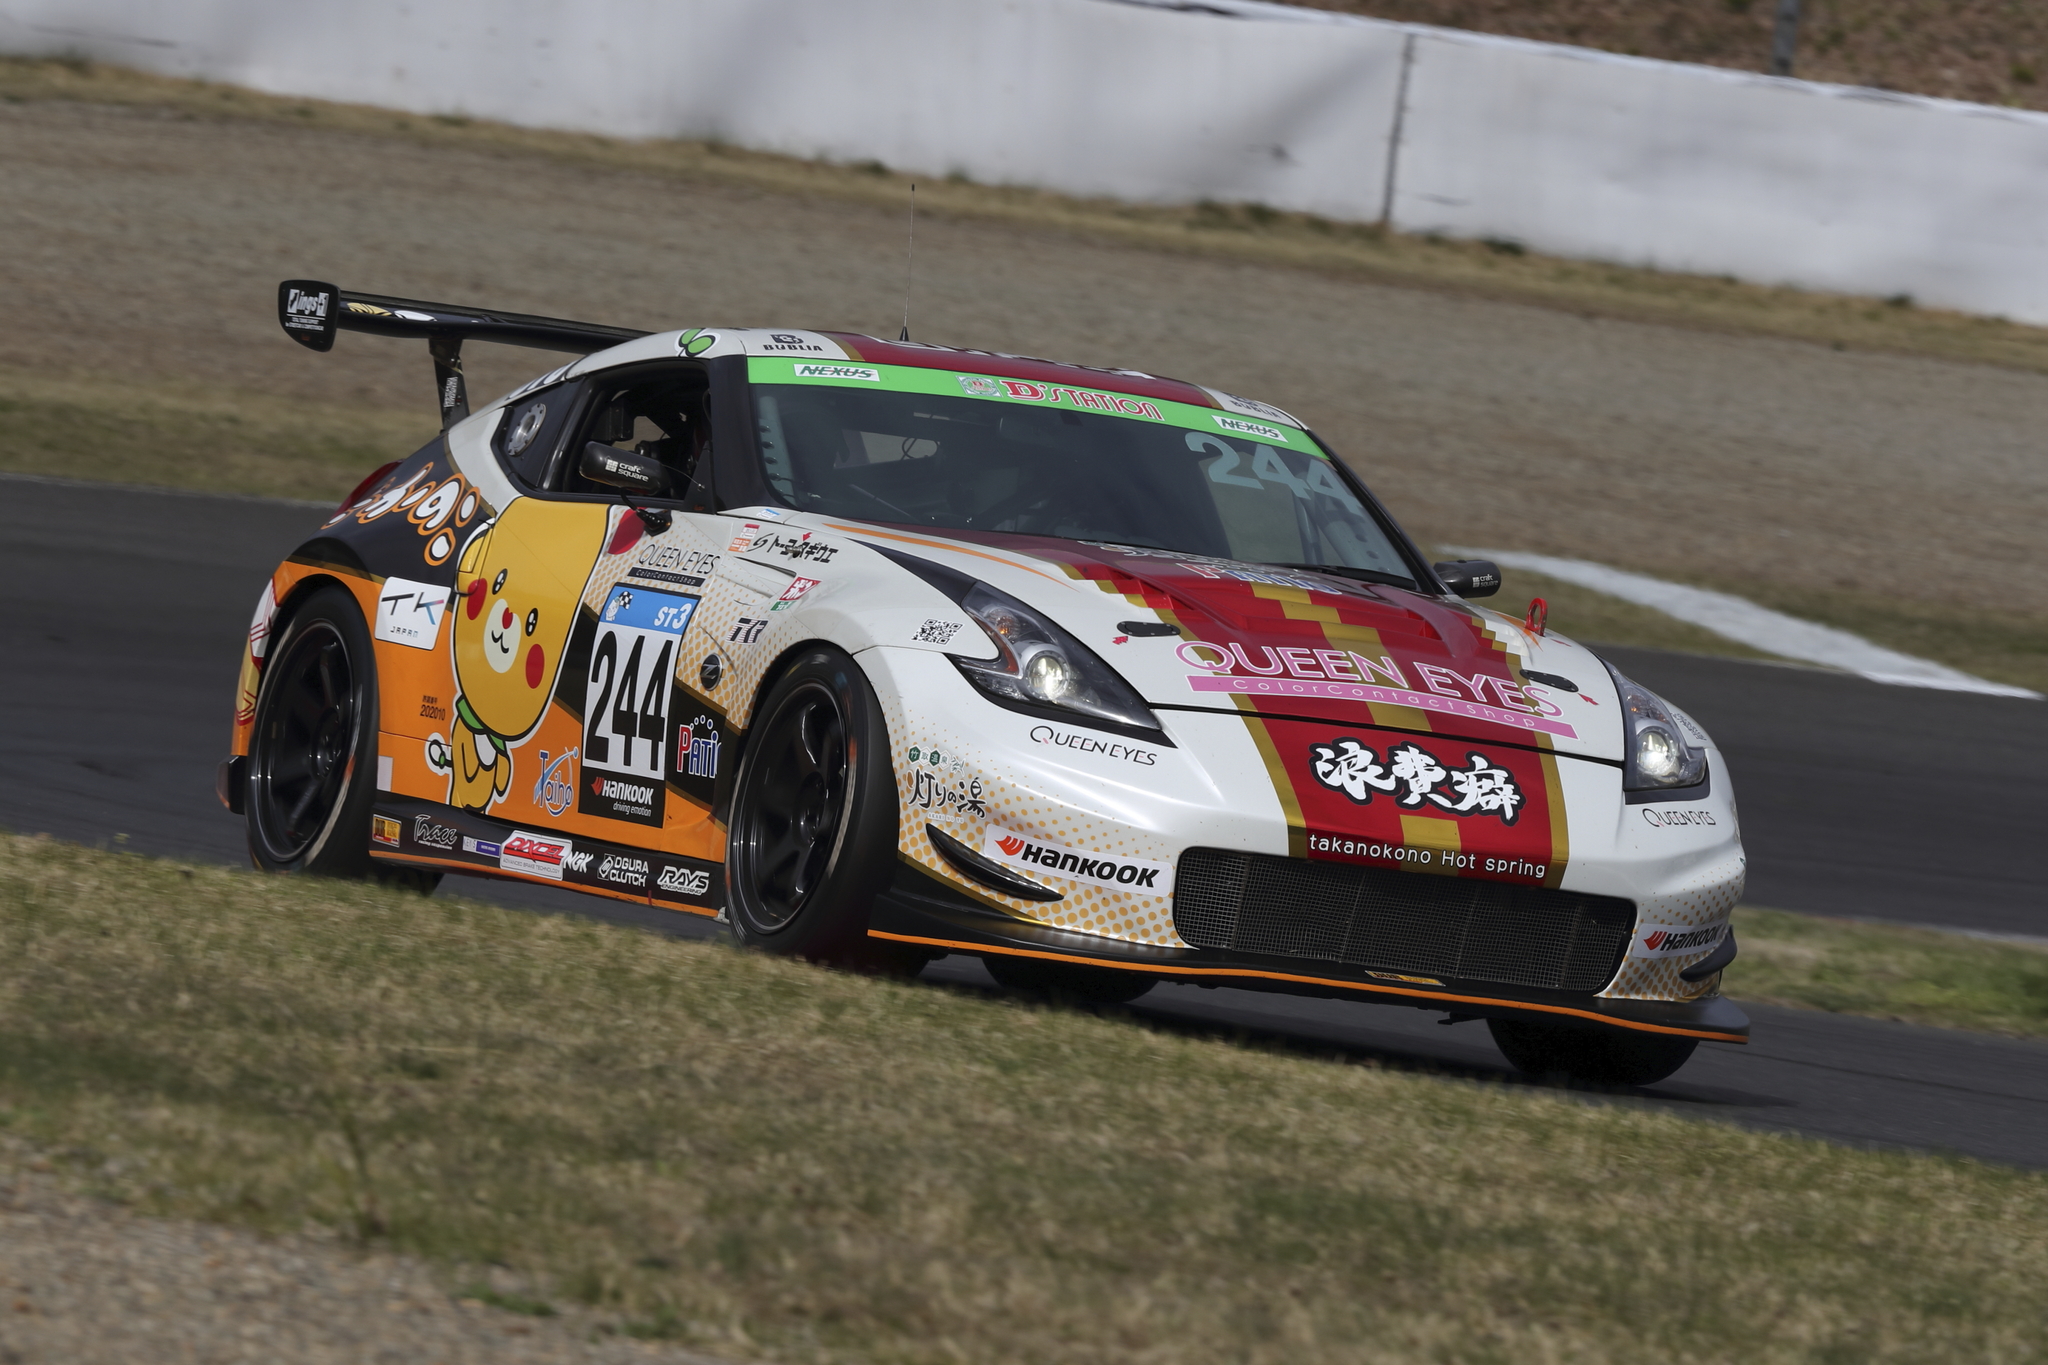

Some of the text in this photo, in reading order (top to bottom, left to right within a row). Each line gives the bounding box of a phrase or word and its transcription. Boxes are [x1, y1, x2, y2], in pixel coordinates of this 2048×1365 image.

[799, 365, 876, 379] NEXUS
[999, 379, 1165, 422] D'STATION
[1220, 418, 1280, 438] NEXUS
[617, 468, 649, 482] square
[619, 462, 642, 474] craft
[1185, 431, 1366, 518] 244
[638, 543, 721, 575] QUEEN EYES
[380, 591, 445, 626] TK
[652, 602, 693, 630] ST3
[390, 625, 419, 639] JAPAN
[1174, 640, 1565, 718] QUEEN EYES
[584, 630, 674, 772] 244
[1029, 725, 1158, 766] QUEEN EYES
[907, 768, 987, 819] 灯りの湯
[612, 801, 652, 817] driving emotion
[1642, 808, 1717, 828] QUEEN EYES
[413, 814, 458, 845] Trace
[563, 850, 594, 873] NGK
[614, 856, 649, 874] OGURA
[1309, 834, 1546, 878] takanokono Hot spring
[609, 869, 647, 888] CLUTCH
[657, 865, 710, 893] RAYS
